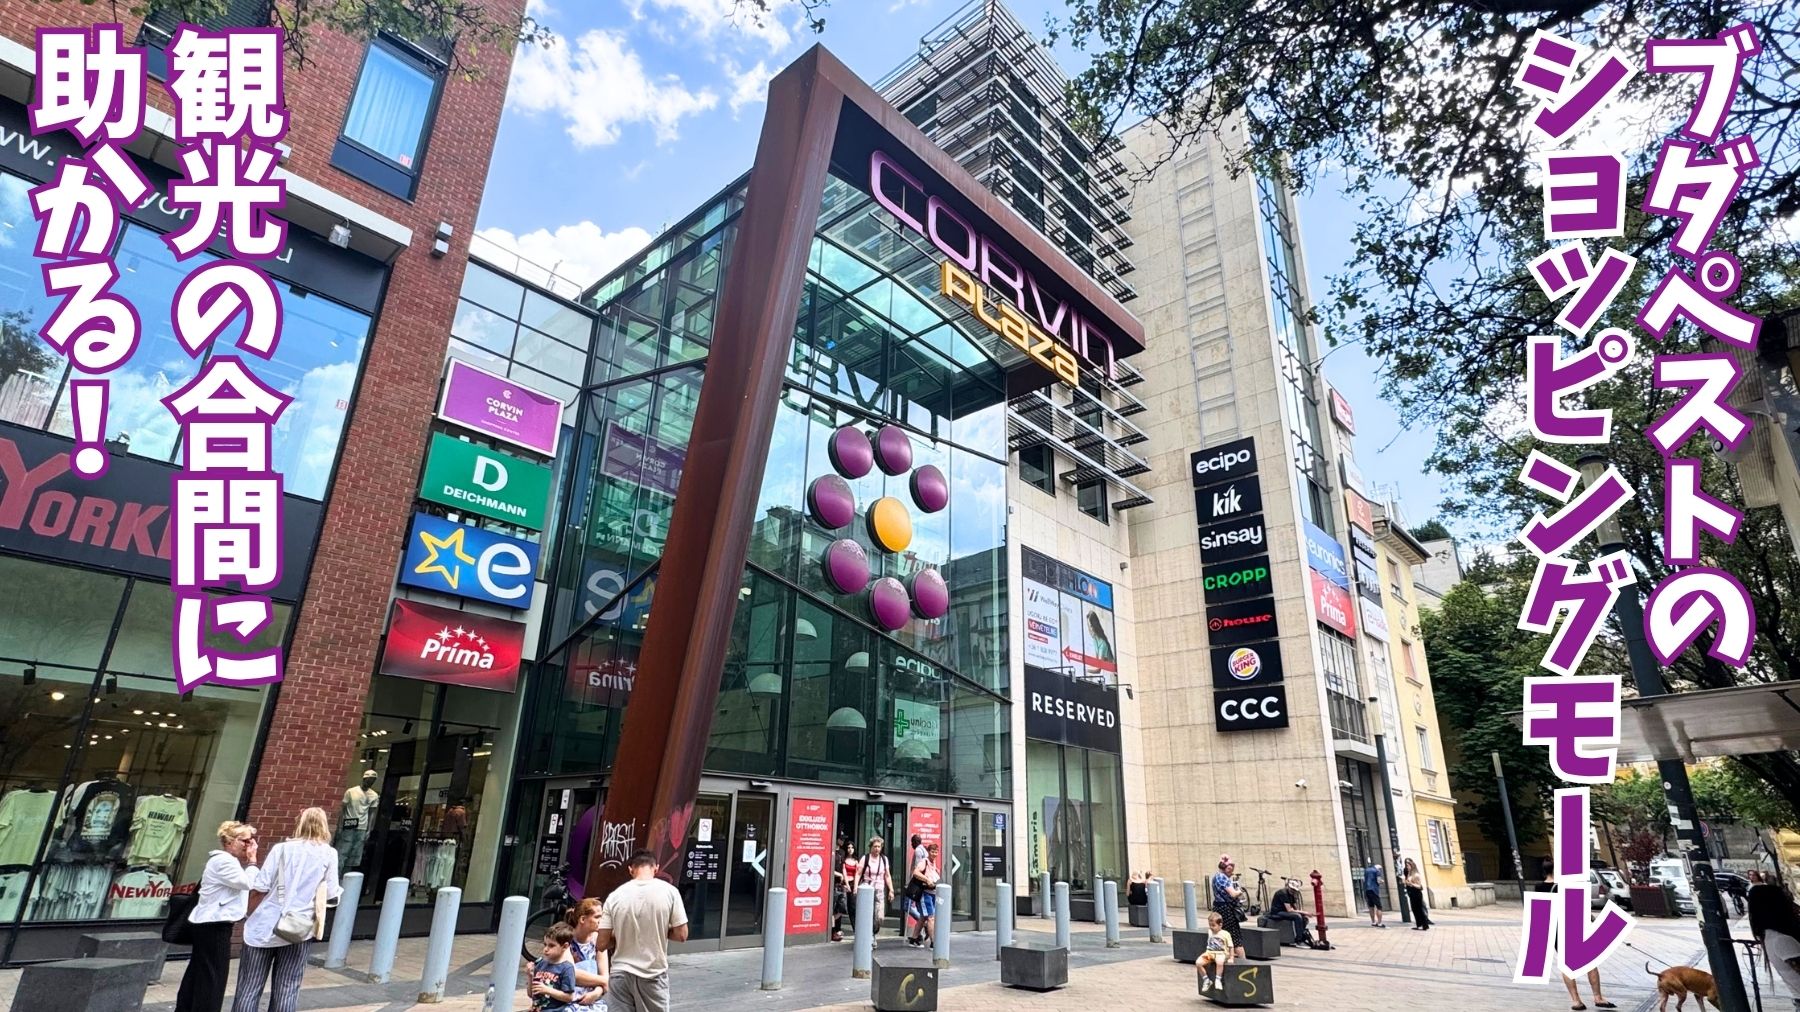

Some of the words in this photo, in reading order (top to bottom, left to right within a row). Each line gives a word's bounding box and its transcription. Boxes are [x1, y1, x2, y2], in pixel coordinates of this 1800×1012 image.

[486, 397, 524, 416] CORVIN
[488, 406, 519, 423] PLAZA
[472, 455, 508, 491] D
[1196, 449, 1251, 475] ecipo
[444, 485, 527, 518] DEICHMANN
[1201, 525, 1263, 551] sinsay
[1308, 538, 1345, 575] euronics
[477, 543, 531, 599] e
[1204, 567, 1267, 590] CROPP
[1223, 613, 1274, 628] house
[1233, 653, 1254, 666] BURGER
[1234, 658, 1257, 673] KING
[1032, 692, 1115, 728] RESERVED
[1221, 696, 1281, 721] CCC
[148, 811, 175, 822] HAWAII
